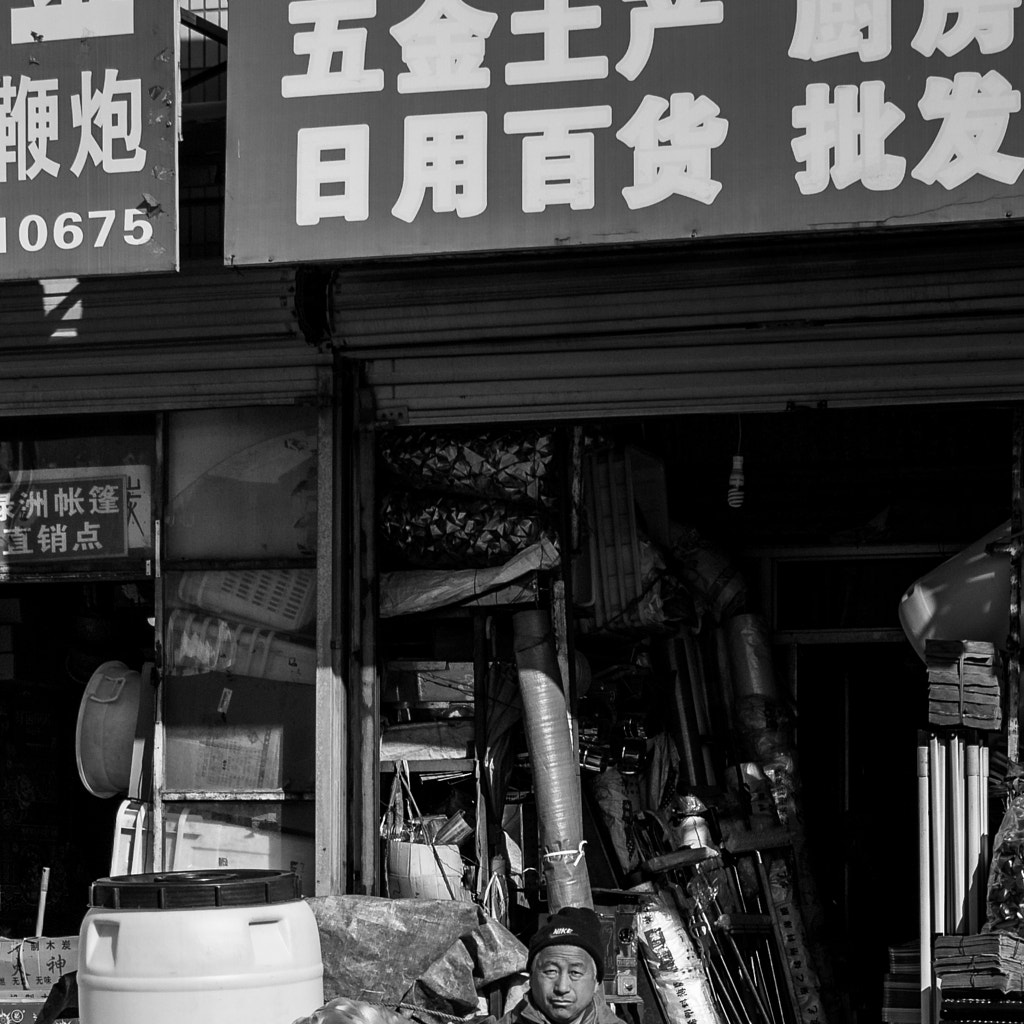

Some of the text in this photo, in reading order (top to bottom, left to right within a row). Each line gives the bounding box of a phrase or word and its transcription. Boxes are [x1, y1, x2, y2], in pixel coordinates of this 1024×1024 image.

[281, 0, 726, 98] 五金土产
[295, 69, 1024, 226] 日用百货 批发
[2, 521, 103, 555] 直销点
